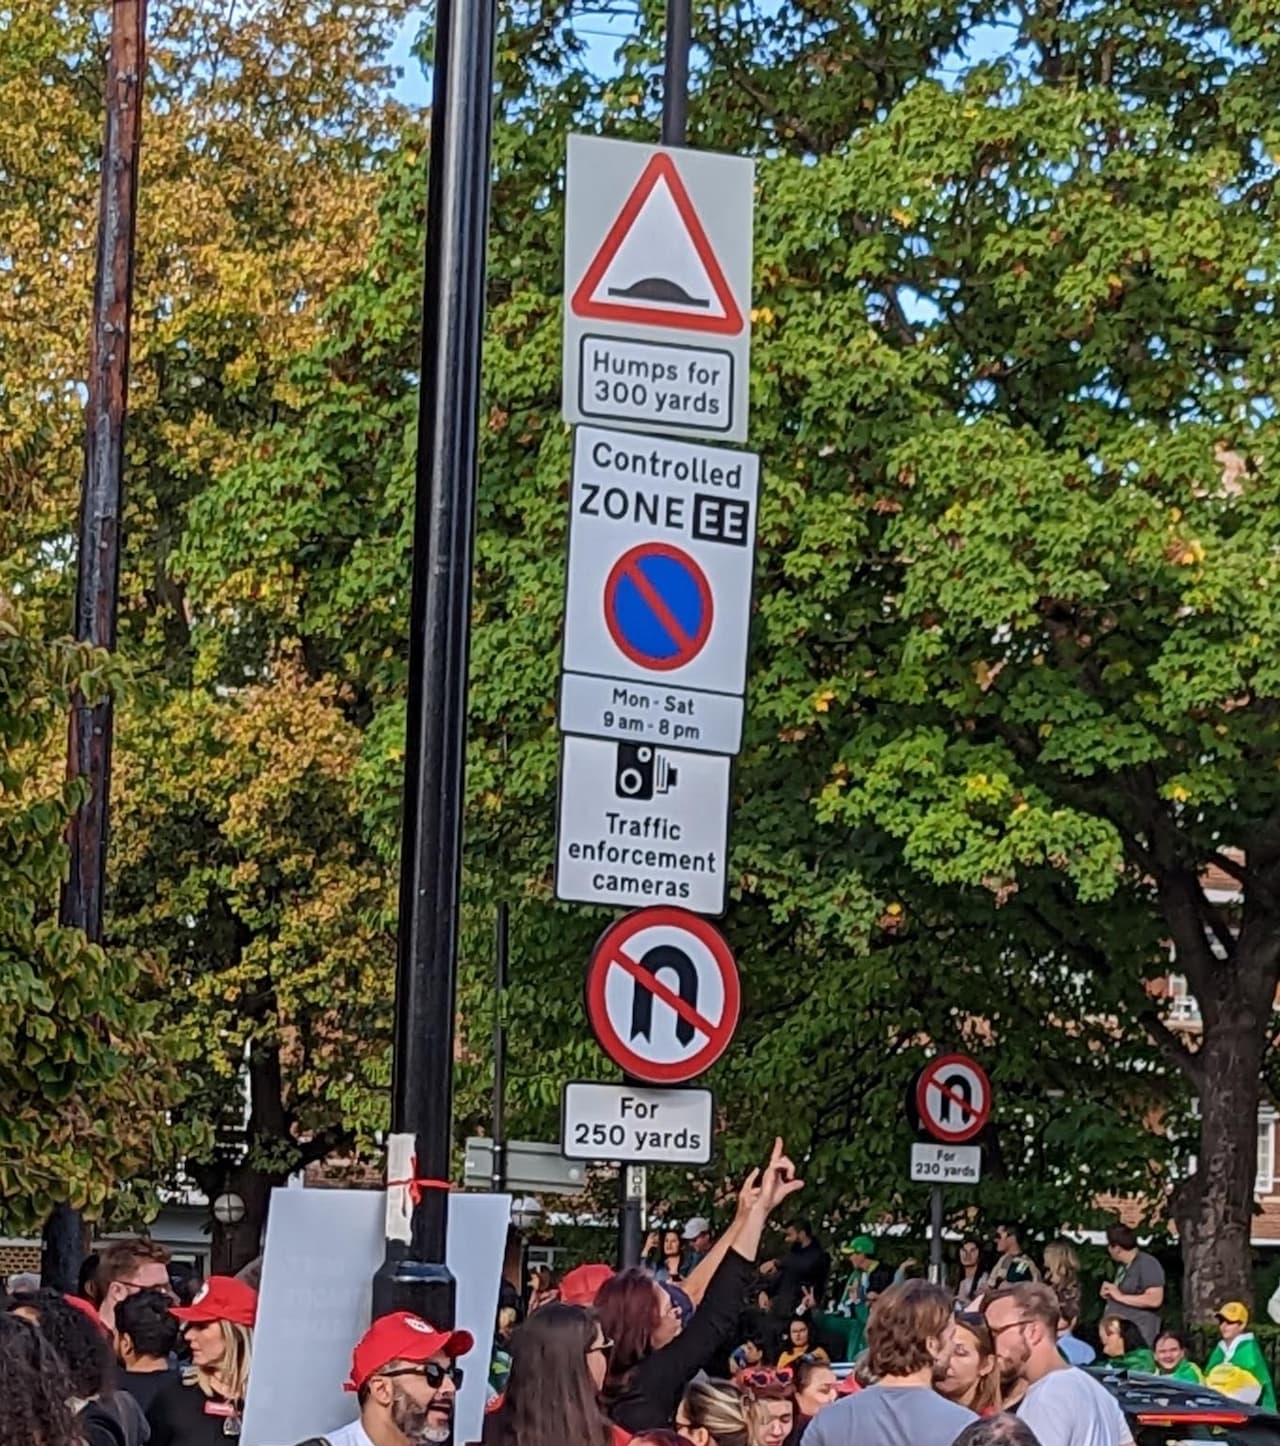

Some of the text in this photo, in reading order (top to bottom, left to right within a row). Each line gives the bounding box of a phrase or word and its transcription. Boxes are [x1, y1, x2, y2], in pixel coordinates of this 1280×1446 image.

[592, 349, 721, 387] Humps for
[595, 380, 720, 416] 300 yards
[592, 441, 743, 490] Controlled
[579, 483, 746, 542] ZONE EE
[612, 688, 650, 710] Mon
[664, 693, 695, 716] Sat
[605, 812, 681, 841] Traffic
[568, 840, 717, 874] enforcement
[592, 871, 691, 898] cameras
[620, 1096, 659, 1120] For
[574, 1122, 702, 1151] 250 yards
[915, 1162, 976, 1177] 230 yards
[936, 1150, 956, 1162] For
